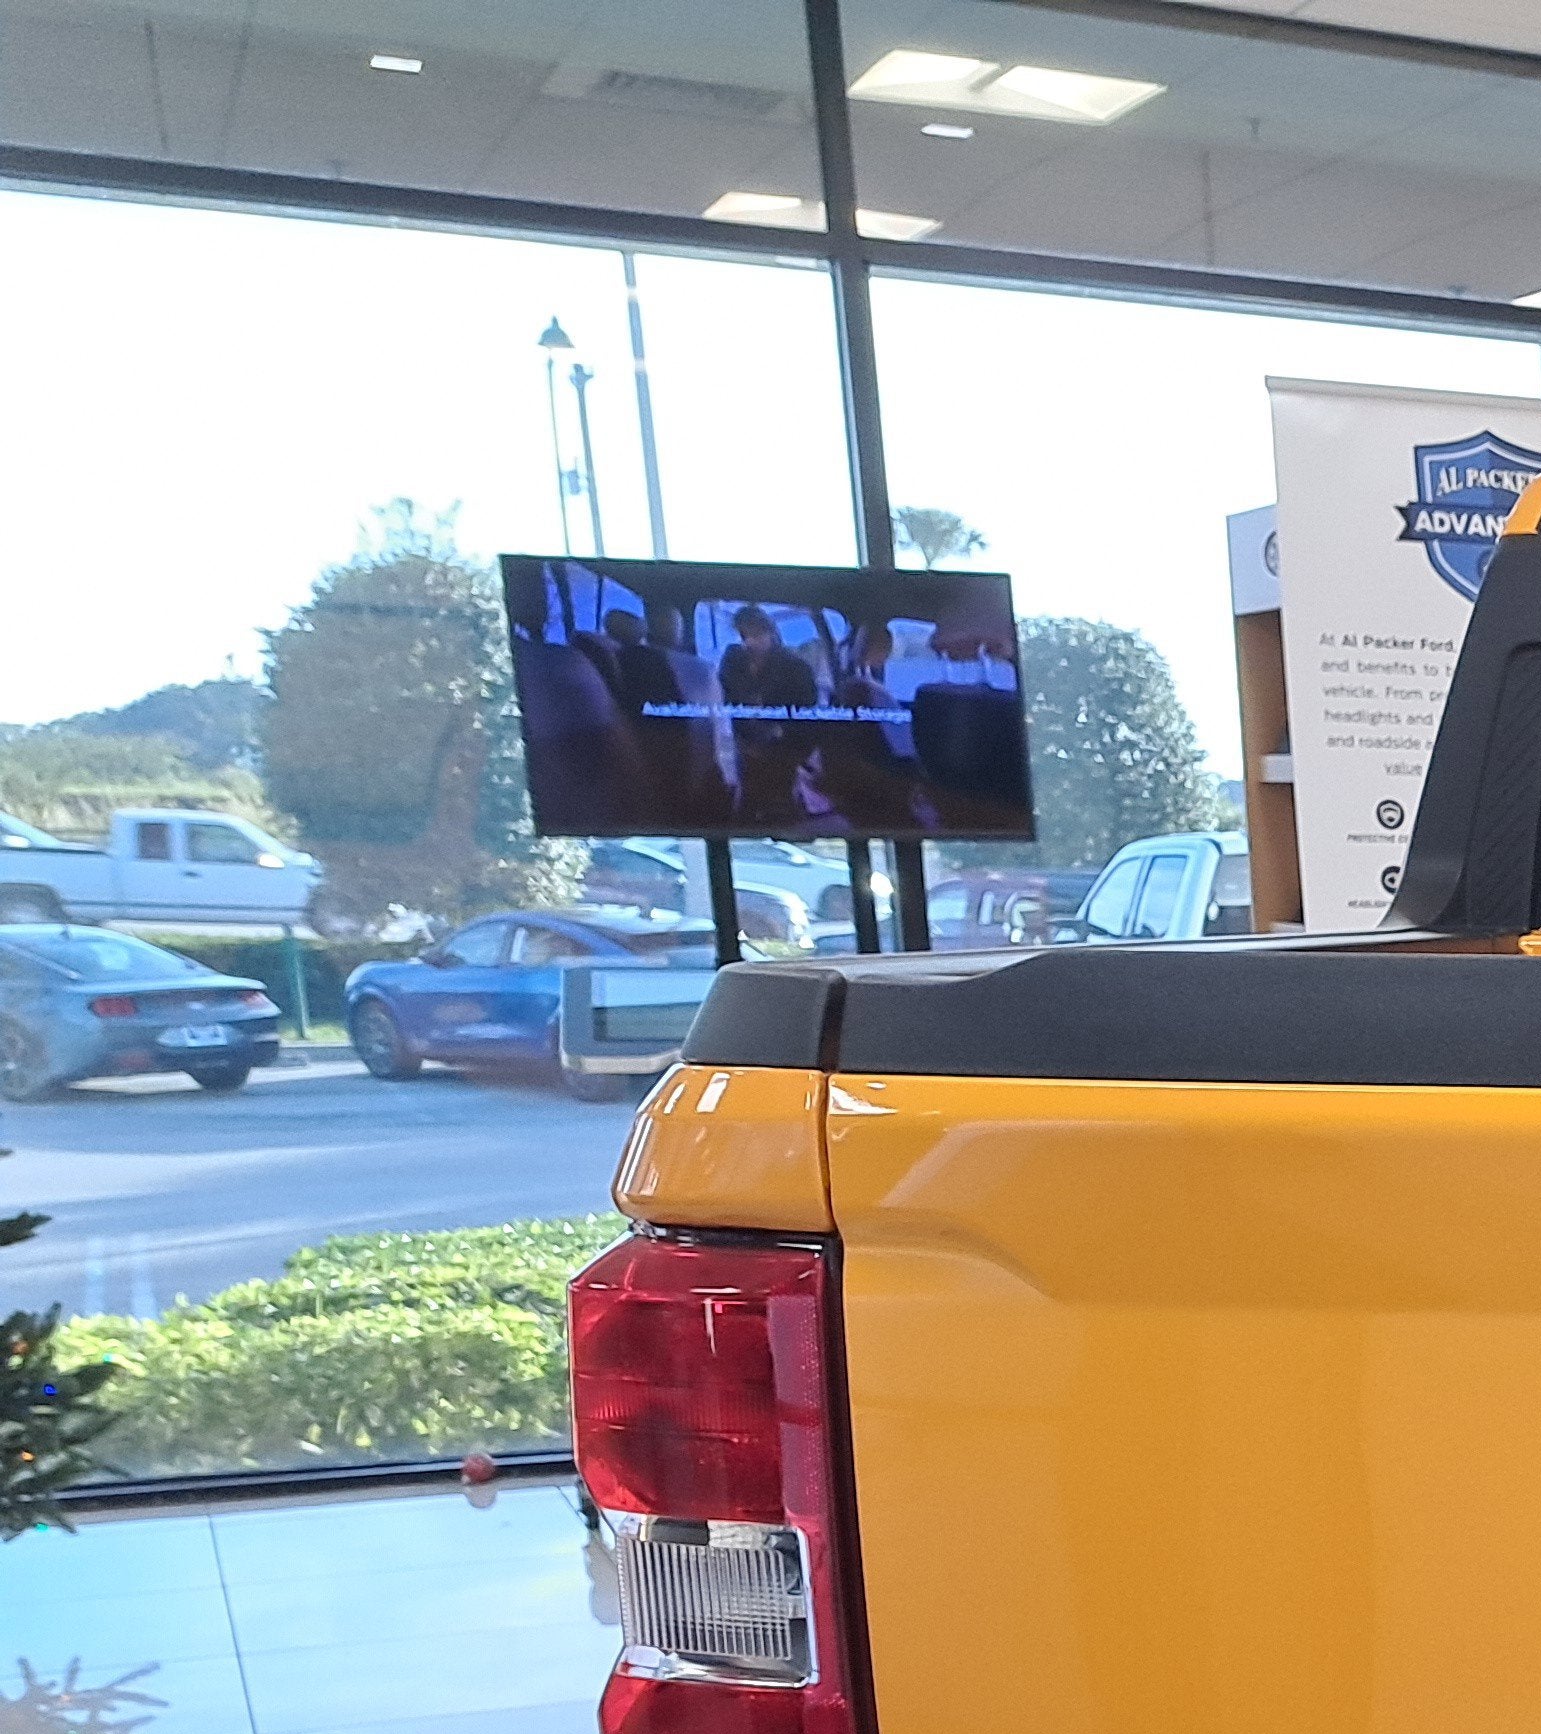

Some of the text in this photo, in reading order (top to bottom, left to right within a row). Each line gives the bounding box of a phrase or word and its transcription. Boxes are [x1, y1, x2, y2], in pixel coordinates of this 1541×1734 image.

[1436, 466, 1534, 496] AL PACKE
[1414, 510, 1504, 537] ADVAN
[1342, 634, 1357, 647] Al
[1363, 634, 1415, 650] Packer
[1321, 660, 1349, 673] and
[1358, 661, 1417, 676] benefits
[1424, 663, 1439, 677] to
[1385, 686, 1423, 700] From
[1324, 709, 1433, 726] headlights and
[1327, 736, 1355, 748] and
[1358, 736, 1421, 750] roadside
